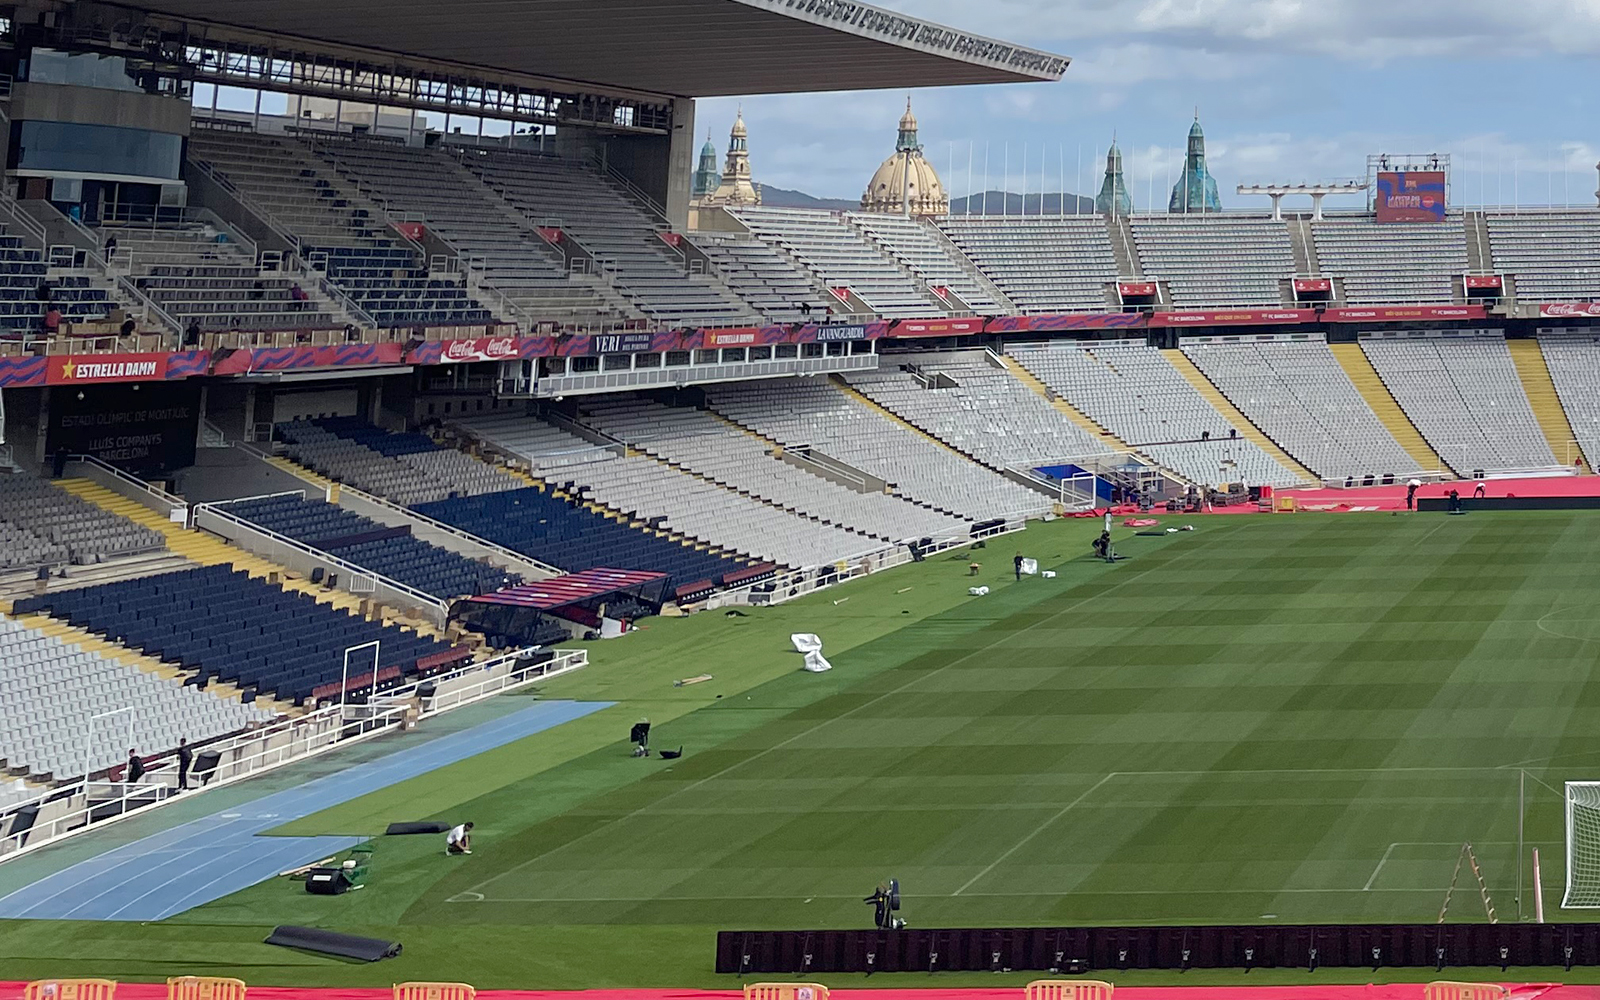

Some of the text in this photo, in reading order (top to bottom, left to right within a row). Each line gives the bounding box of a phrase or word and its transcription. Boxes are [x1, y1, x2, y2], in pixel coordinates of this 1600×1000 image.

[596, 335, 620, 352] VERI
[76, 361, 157, 378] ESTRELLA DAMM
